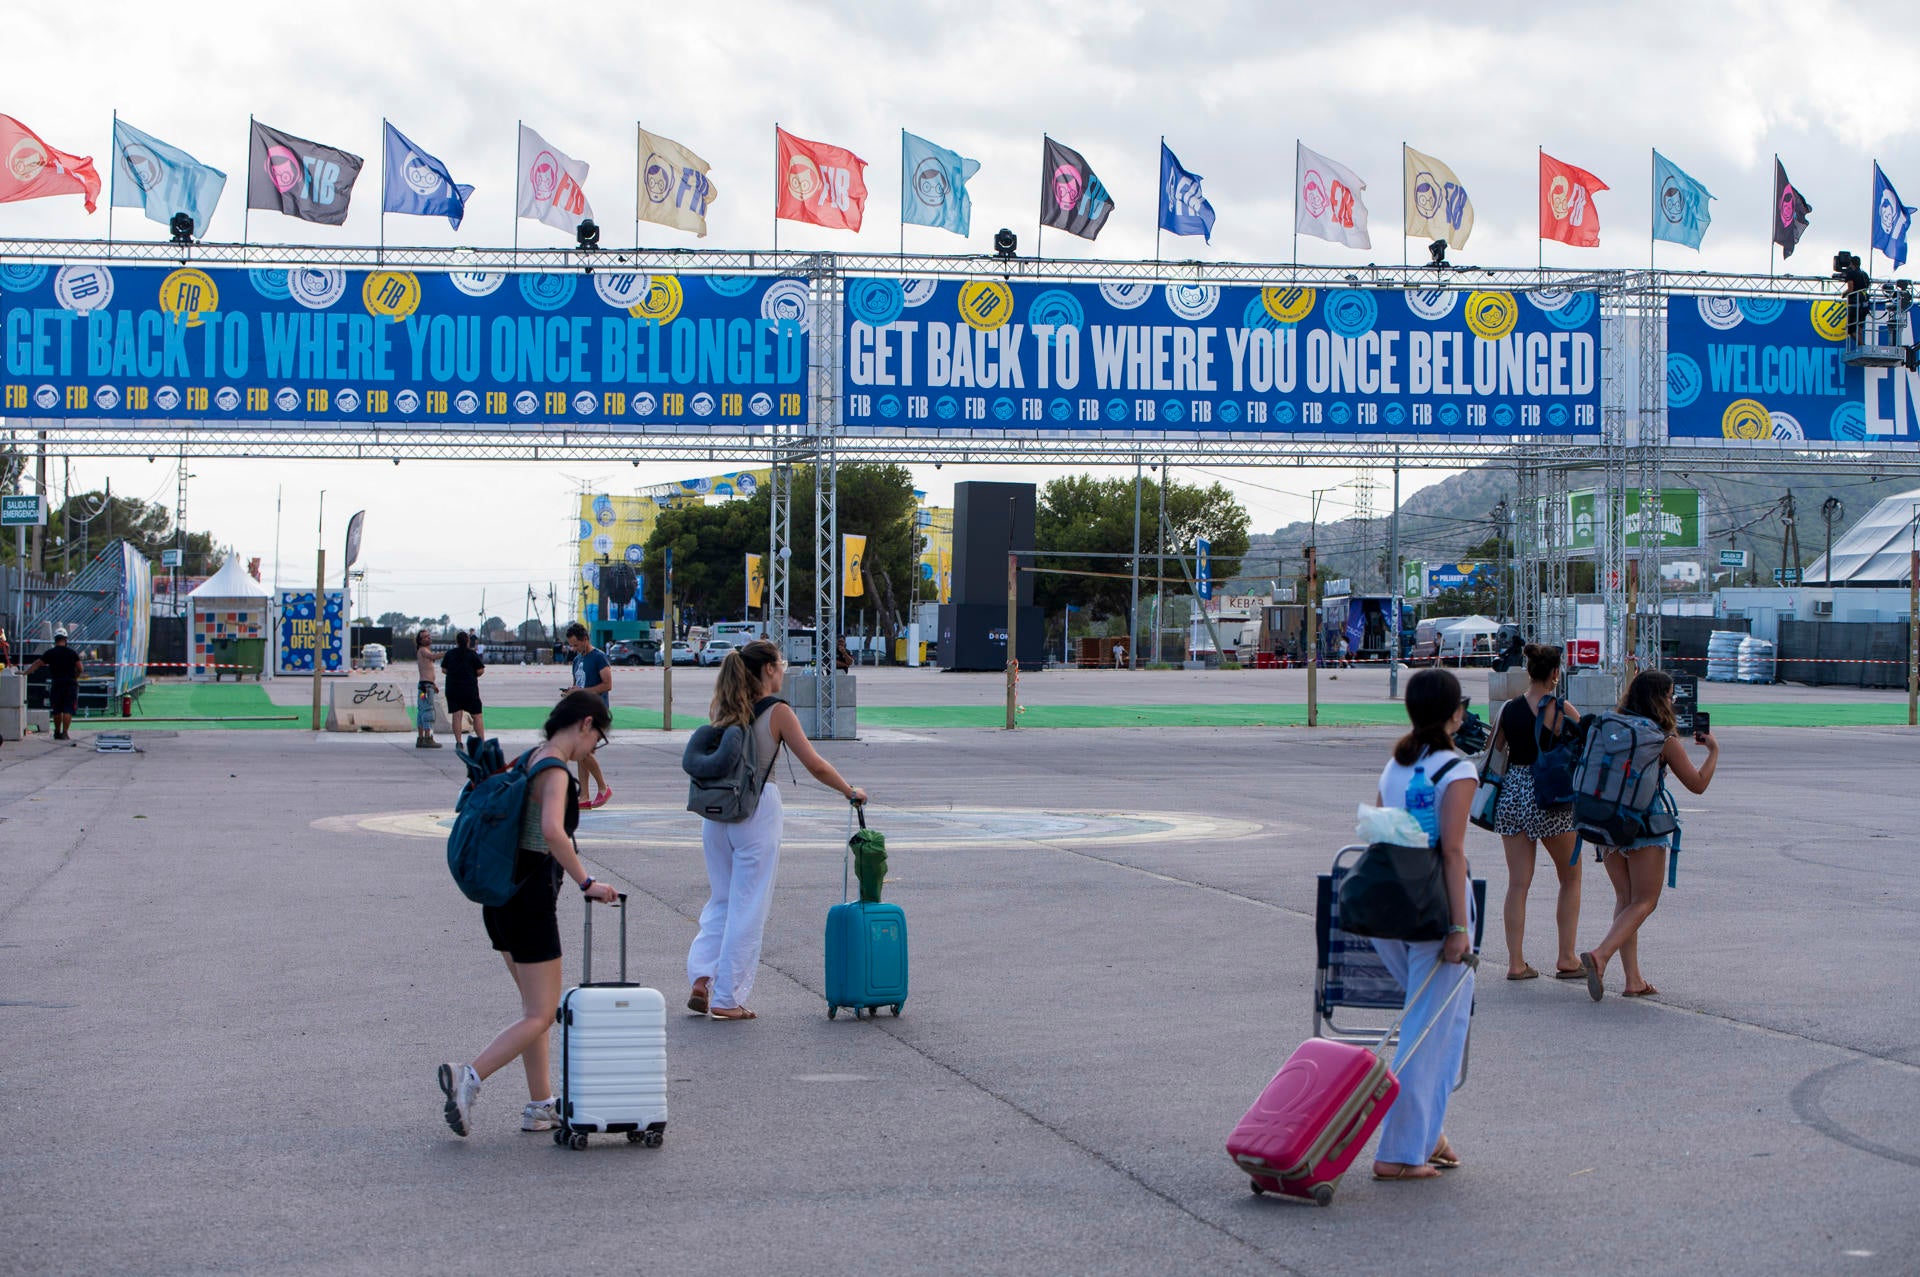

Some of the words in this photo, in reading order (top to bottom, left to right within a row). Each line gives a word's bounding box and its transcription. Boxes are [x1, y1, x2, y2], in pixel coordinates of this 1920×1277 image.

[302, 155, 340, 205] FIB
[817, 165, 850, 212] FIB
[68, 272, 100, 300] FIB
[176, 282, 201, 313] FIB
[376, 276, 407, 310] FIB
[970, 286, 1001, 318] FIB
[6, 308, 79, 377] GET
[87, 308, 191, 379] BACK
[198, 310, 249, 379] TO
[260, 311, 396, 381] WHERE
[404, 312, 480, 383] YOU
[490, 314, 593, 383] ONCE
[601, 316, 801, 384] BELONGED
[850, 320, 919, 387] GET
[927, 322, 1025, 389] BACK
[1031, 323, 1081, 390] TO
[1090, 325, 1218, 391] WHERE
[1225, 327, 1297, 393] YOU
[1306, 328, 1400, 394] ONCE
[1409, 331, 1595, 396] BELONGED
[6, 386, 27, 408] FIB
[66, 387, 88, 409] FIB
[126, 387, 148, 409] FIB
[186, 388, 209, 410] FIB
[246, 388, 268, 411] FIB
[307, 389, 329, 411] FIB
[367, 390, 389, 413] FIB
[427, 391, 448, 413] FIB
[486, 391, 507, 414] FIB
[545, 392, 566, 414] FIB
[604, 393, 625, 415] FIB
[663, 393, 684, 415] FIB
[722, 394, 743, 416] FIB
[780, 394, 801, 416] FIB
[850, 394, 871, 417] FIB
[907, 396, 929, 418] FIB
[965, 397, 986, 419] FIB
[1022, 398, 1043, 420] FIB
[1078, 399, 1100, 421] FIB
[1135, 400, 1156, 421] FIB
[1191, 400, 1212, 422] FIB
[1247, 401, 1267, 423] FIB
[1302, 402, 1323, 424] FIB
[1357, 403, 1378, 425] FIB
[1412, 403, 1433, 425] FIB
[1466, 404, 1487, 426] FIB
[1521, 405, 1541, 426] FIB
[1574, 405, 1595, 426] FIB
[3, 510, 39, 518] EMERGENCIA
[7, 501, 27, 509] SALIDA
[28, 500, 36, 509] DE
[290, 635, 331, 649] OFICAL
[291, 619, 331, 634] TIENA
